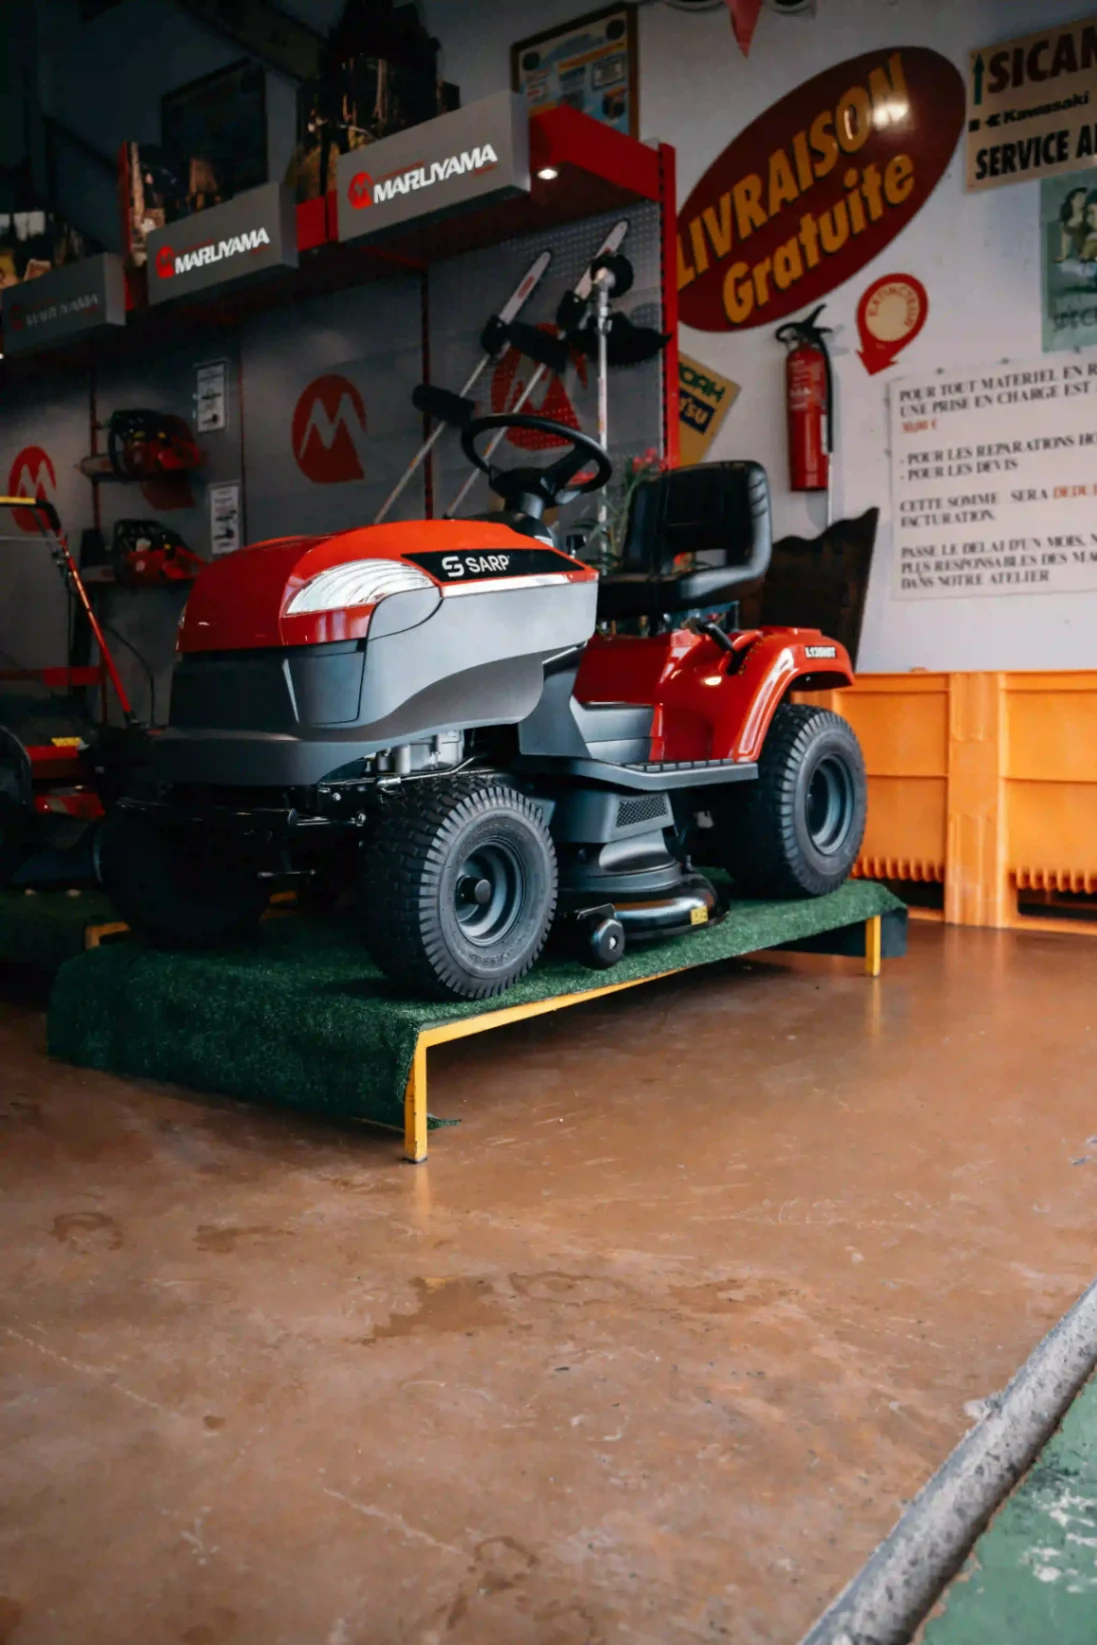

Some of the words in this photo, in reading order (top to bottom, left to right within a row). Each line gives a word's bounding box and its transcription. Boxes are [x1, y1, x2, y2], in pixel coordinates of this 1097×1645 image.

[1003, 91, 1089, 124] Kawasaki
[975, 130, 1069, 180] SERVICE
[1076, 123, 1097, 159] A
[373, 143, 498, 204] MARUYAMA
[676, 53, 911, 292] LIVRAISON
[174, 227, 270, 275] MARUYAMA
[722, 154, 914, 324] Gratuite
[900, 387, 936, 403] POUR
[940, 380, 977, 397] TOUT
[981, 369, 1056, 390] MATERIEL
[1063, 365, 1083, 380] EN
[900, 404, 928, 418] UNE
[932, 396, 971, 414] PRISE
[975, 394, 993, 409] EN
[997, 384, 1060, 405] CHARGE
[1064, 380, 1092, 397] EST
[908, 450, 944, 465] POUR
[948, 447, 973, 462] LES
[976, 435, 1074, 457] REPARATIONS
[908, 466, 944, 481] POUR
[948, 463, 973, 477] LES
[976, 458, 1019, 474] DEVIS
[900, 498, 942, 512] CETTE
[947, 491, 1000, 508] SOMME
[1011, 487, 1048, 502] SERA
[465, 555, 510, 573] SARP
[901, 561, 930, 576] PLUS
[934, 554, 1037, 572] RESPONSABLES
[1042, 552, 1068, 566] DES
[942, 544, 957, 556] LE
[963, 541, 1005, 556] DELAI
[901, 576, 934, 590] DANS
[938, 572, 983, 587] NOTRE
[990, 569, 1050, 584] ATELIER
